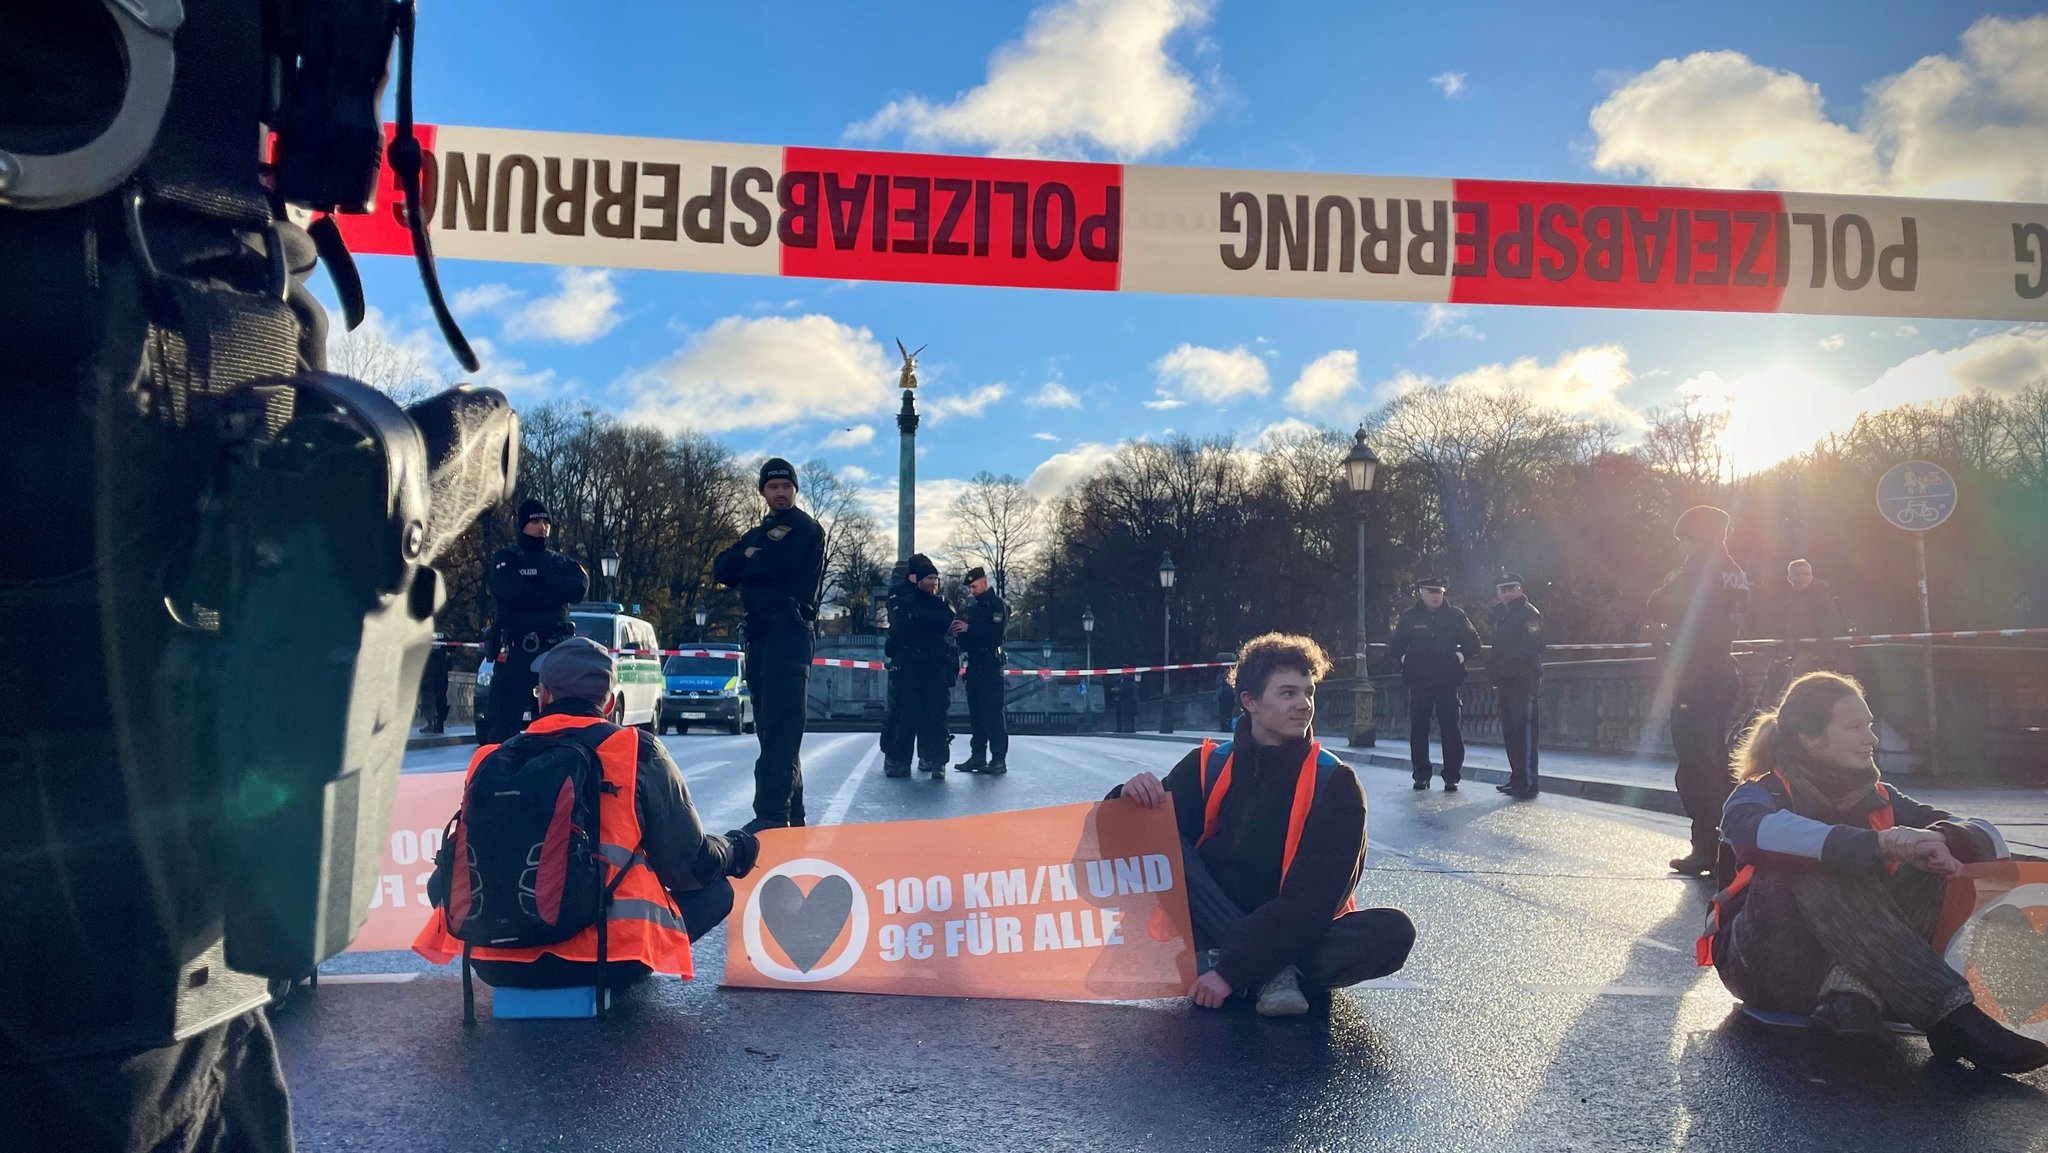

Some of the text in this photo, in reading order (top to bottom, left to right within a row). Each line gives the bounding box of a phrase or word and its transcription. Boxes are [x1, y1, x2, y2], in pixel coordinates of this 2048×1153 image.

[1219, 191, 1919, 293] POLIZEIABSPERRUNG
[767, 469, 790, 477] POLIZEI
[875, 854, 1174, 915] 100 KM/H UND
[878, 907, 1125, 962] 9€ FÜR ALLE
